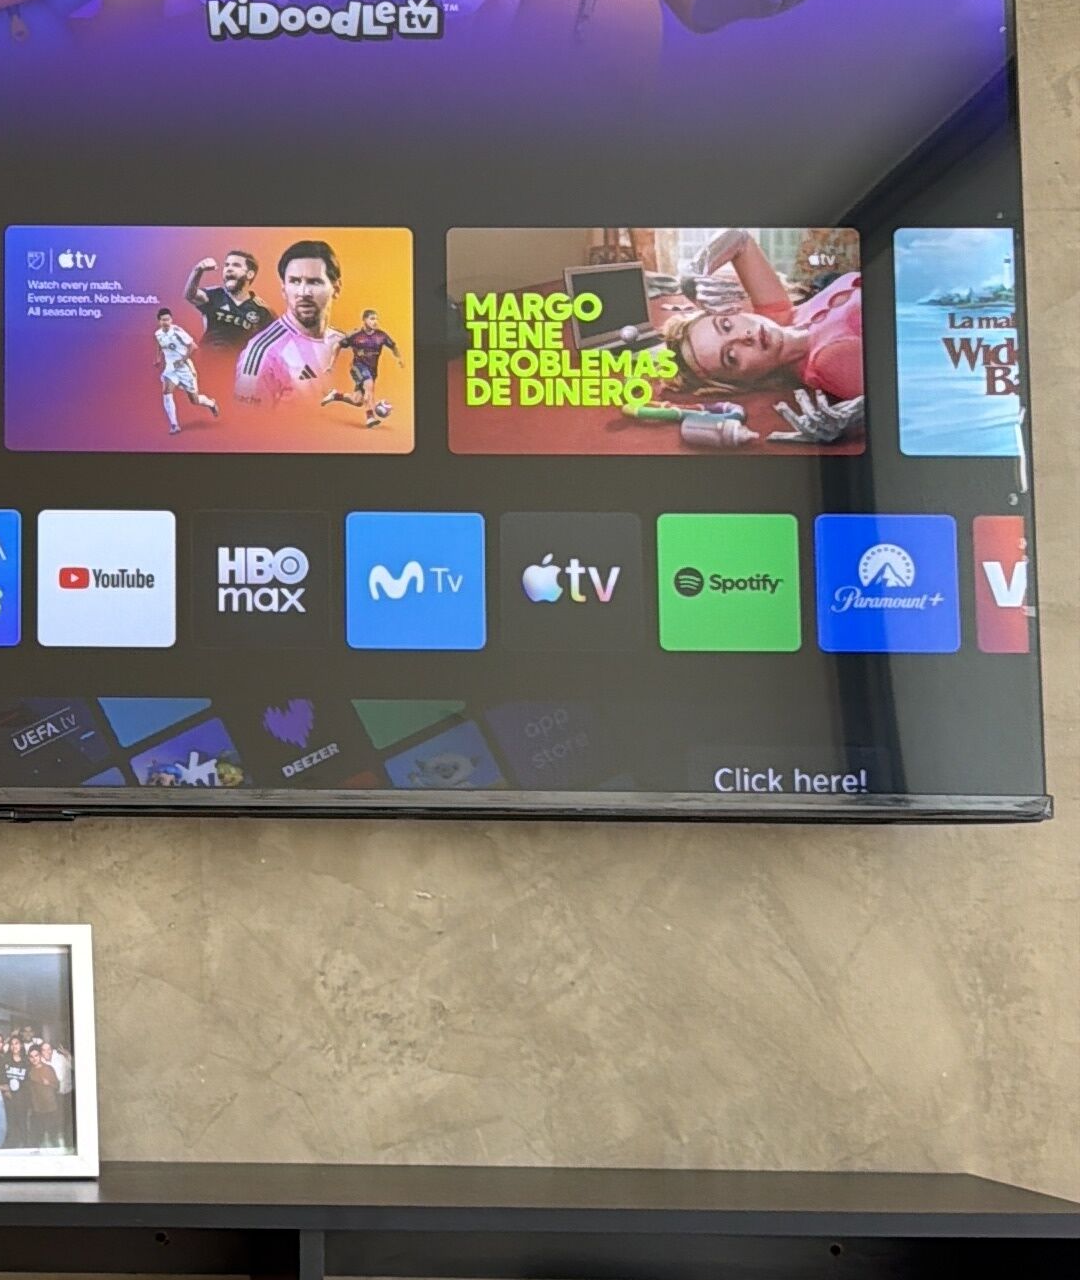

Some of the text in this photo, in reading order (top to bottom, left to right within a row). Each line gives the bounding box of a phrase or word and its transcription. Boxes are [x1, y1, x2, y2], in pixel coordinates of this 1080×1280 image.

[27, 280, 123, 292] Watch every match.
[27, 294, 160, 306] Every screen. No blackouts.
[27, 307, 103, 319] All season long.
[465, 292, 603, 322] MARGO
[947, 312, 974, 329] La
[466, 321, 563, 349] TIENE
[466, 349, 679, 378] PROBLEMAS
[941, 336, 1019, 372] Wid
[467, 377, 653, 407] DE DINERO
[92, 567, 155, 589] YouTube
[217, 546, 309, 584] HBO
[565, 557, 620, 603] tv
[708, 572, 781, 595] Spotify
[217, 586, 306, 613] max
[830, 585, 945, 614] Paramount+
[12, 722, 61, 751] UEFA
[281, 742, 340, 778] DEEZER
[713, 766, 869, 793] Click here!
